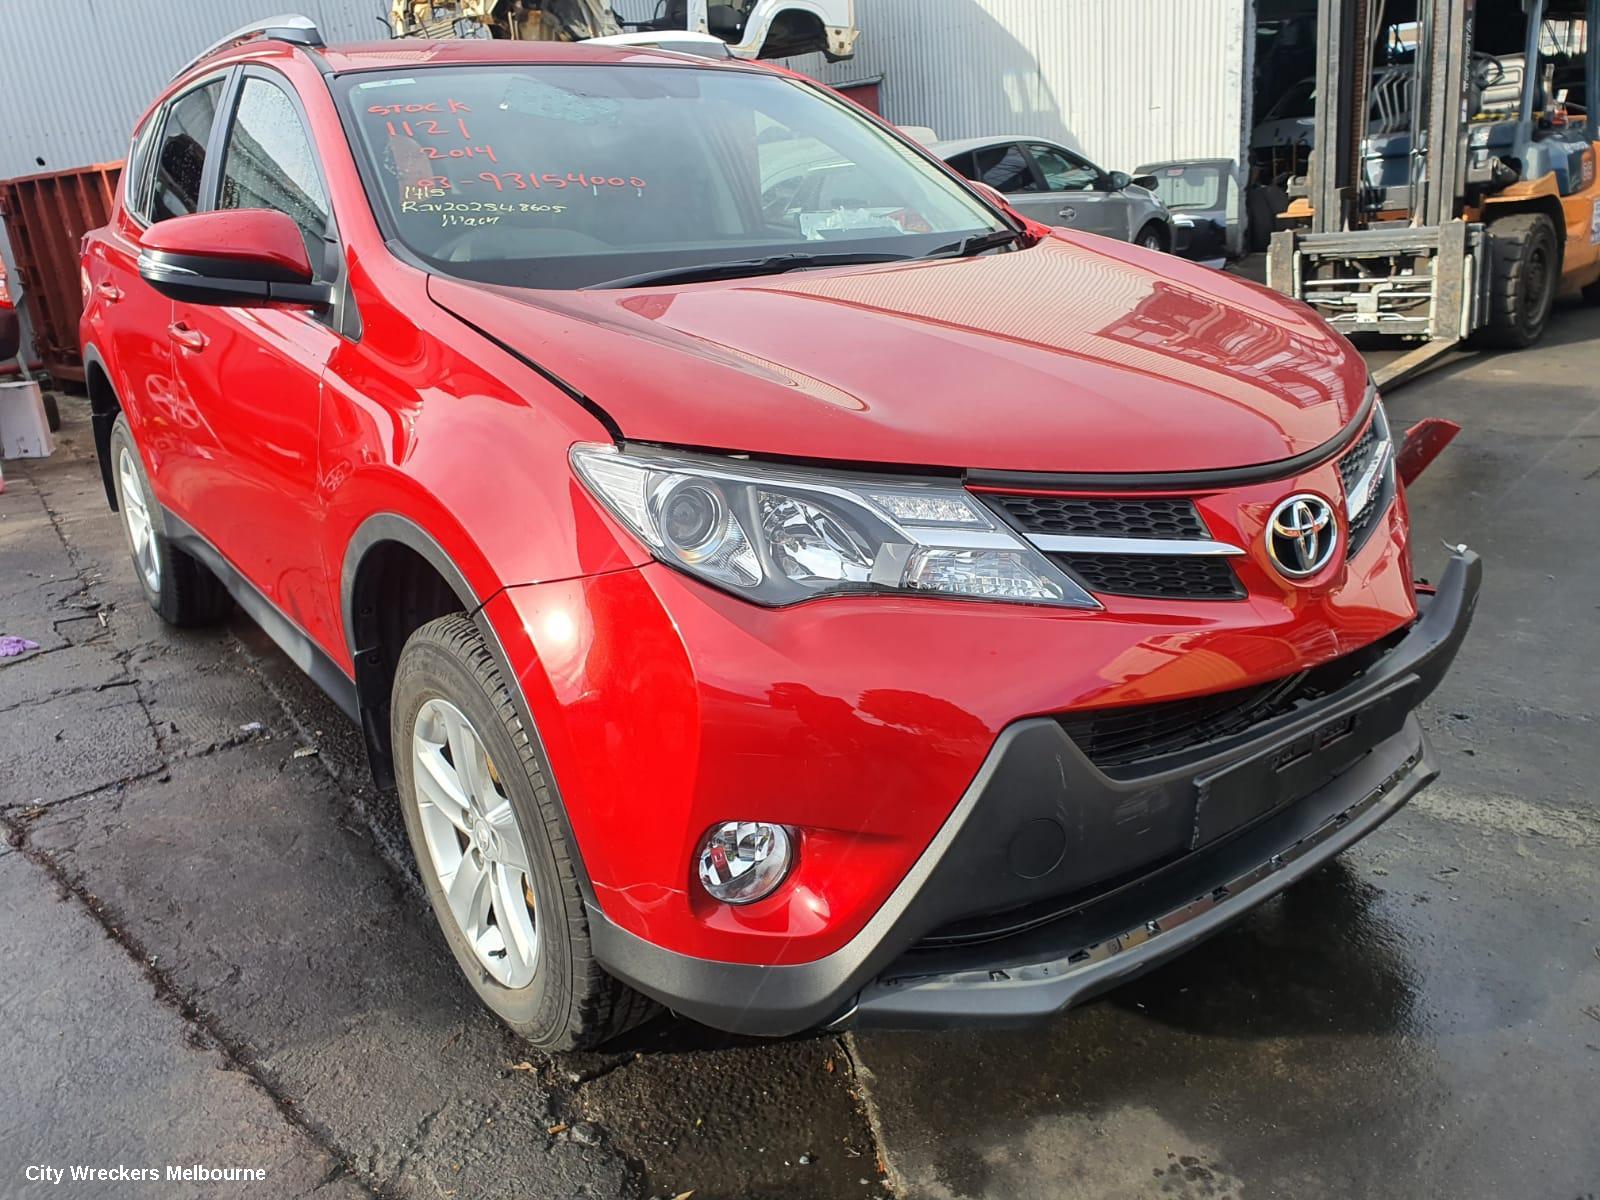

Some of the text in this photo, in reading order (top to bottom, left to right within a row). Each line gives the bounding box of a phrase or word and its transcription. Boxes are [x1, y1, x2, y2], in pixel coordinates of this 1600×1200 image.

[367, 97, 471, 116] STOCK
[386, 118, 471, 139] 1121
[420, 144, 498, 163] 2014
